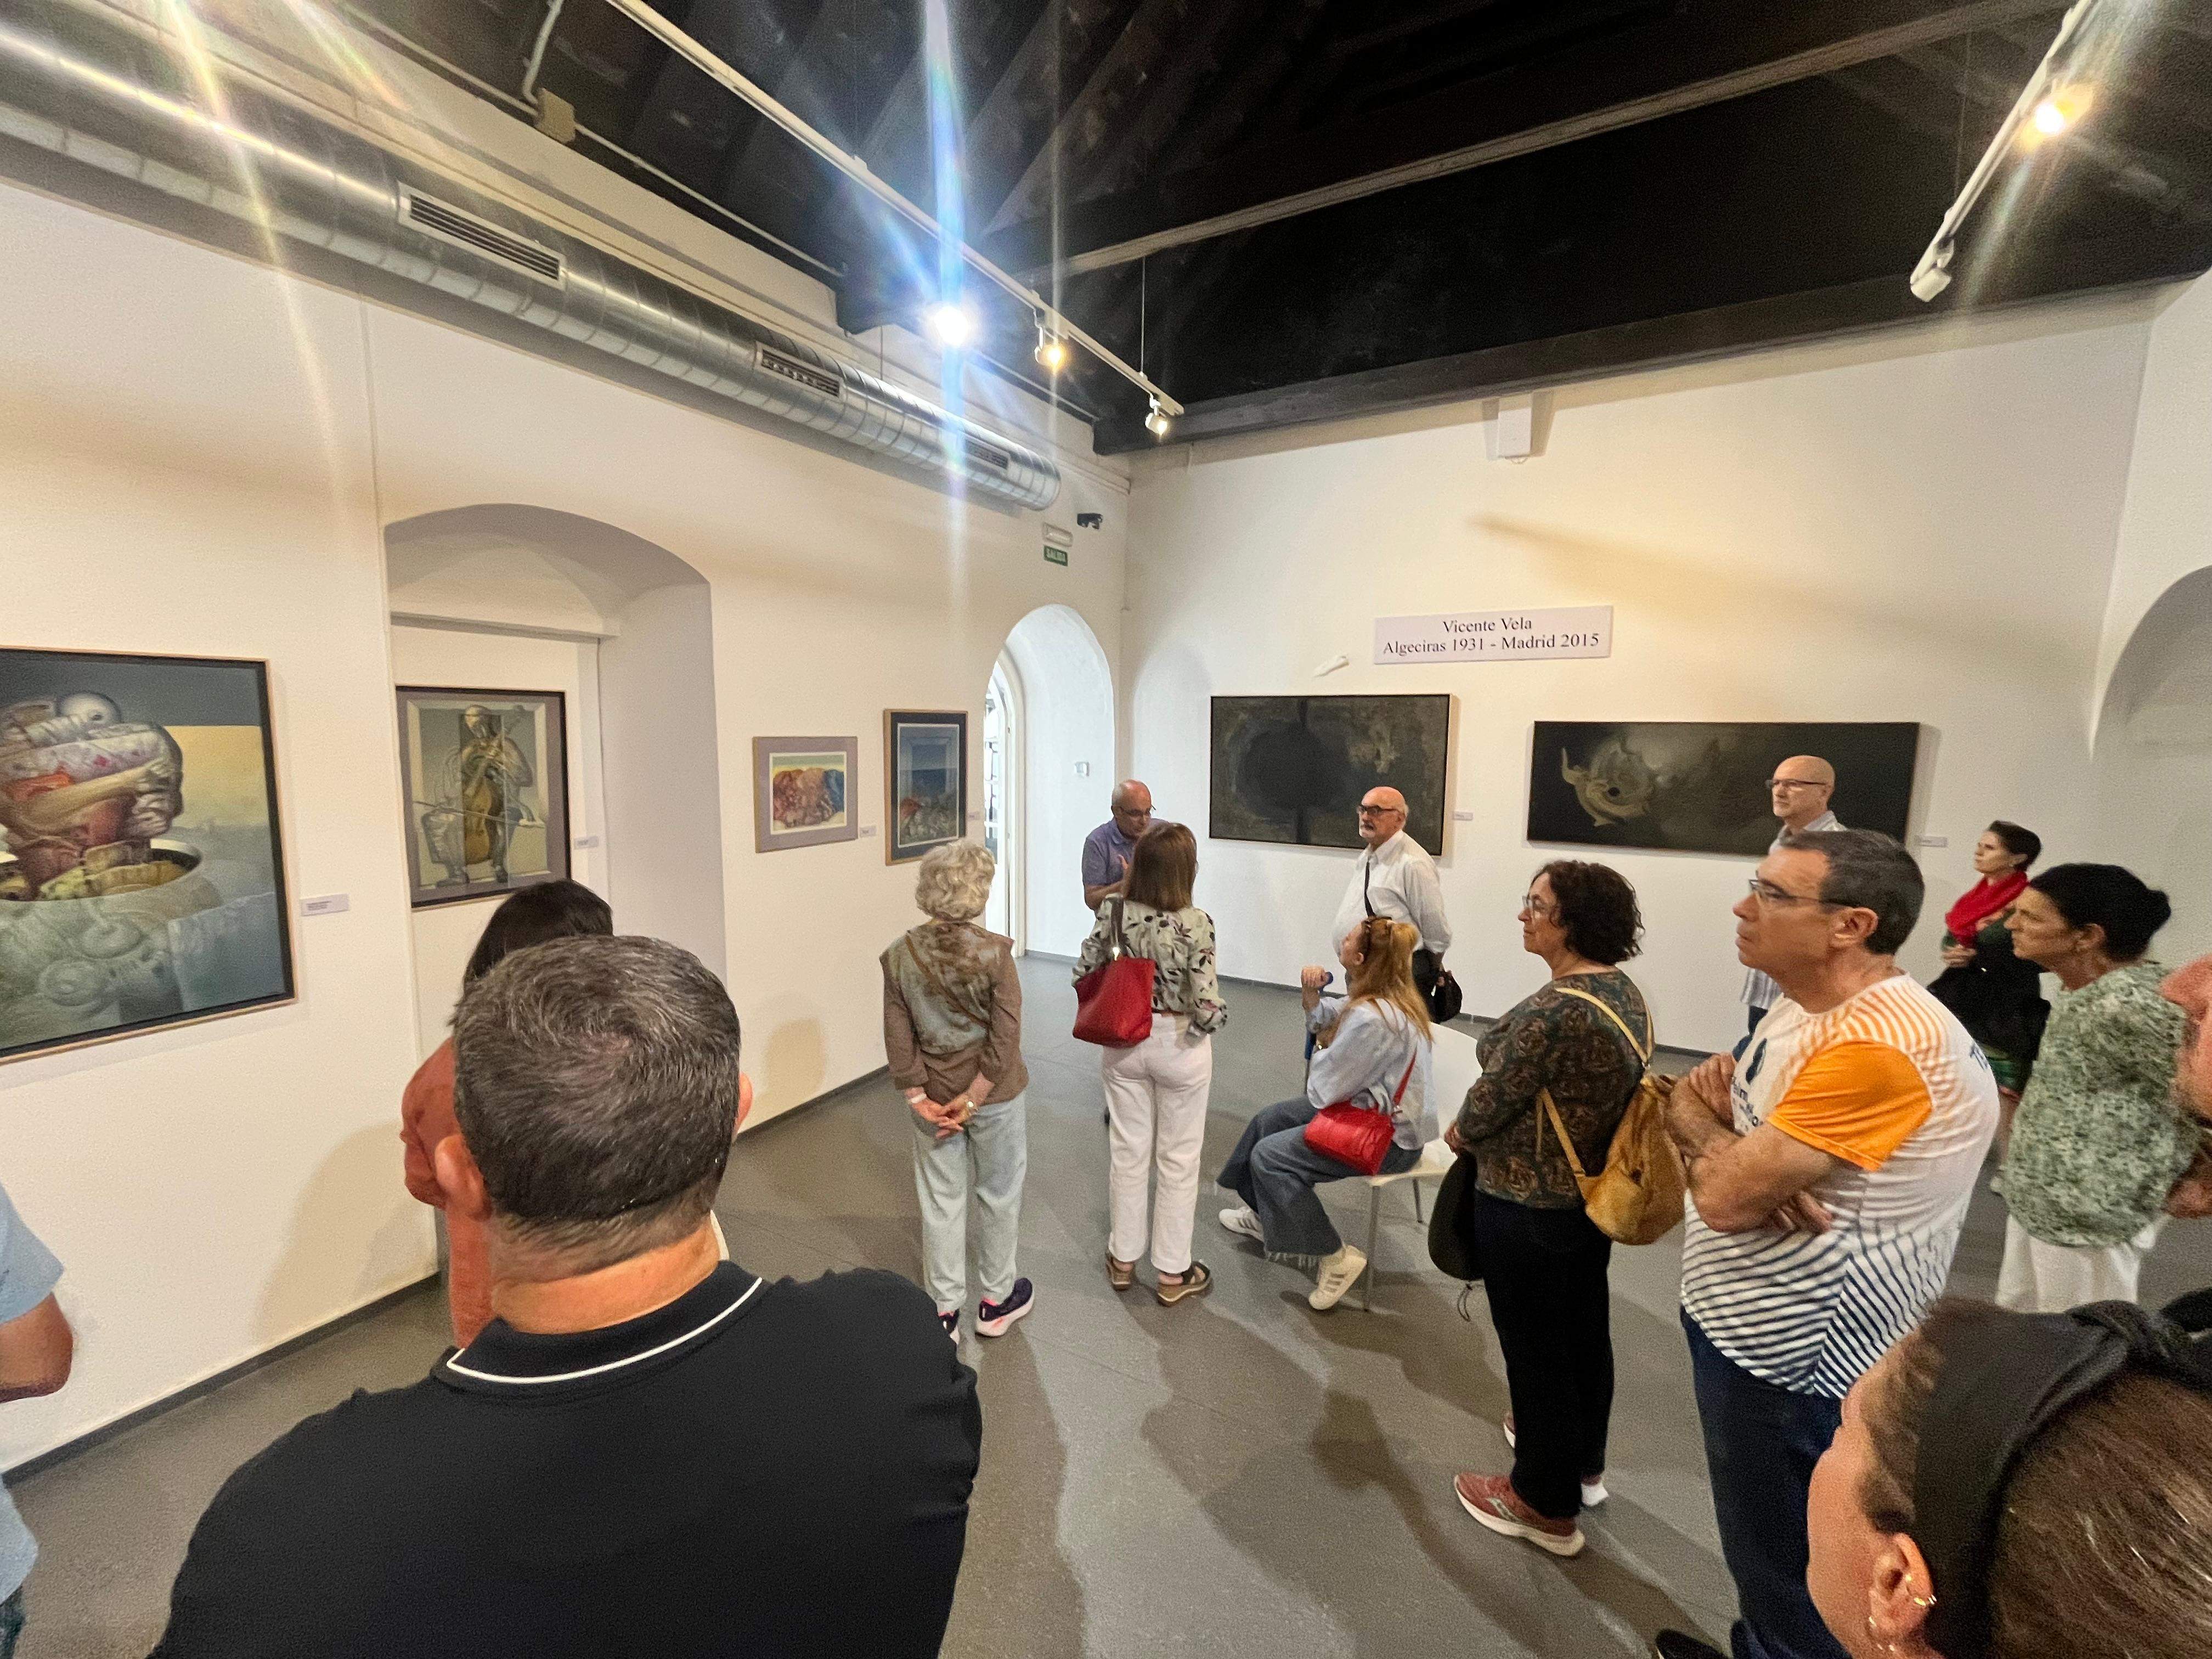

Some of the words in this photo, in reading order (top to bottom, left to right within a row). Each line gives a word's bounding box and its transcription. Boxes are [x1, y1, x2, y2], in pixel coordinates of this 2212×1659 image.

[1443, 619, 1496, 633] Vicente
[1500, 617, 1532, 630] Vela
[1383, 640, 1446, 657] Algeciras
[1453, 637, 1483, 652] 1931
[1502, 634, 1555, 650] Madrid
[1560, 633, 1599, 647] 2015
